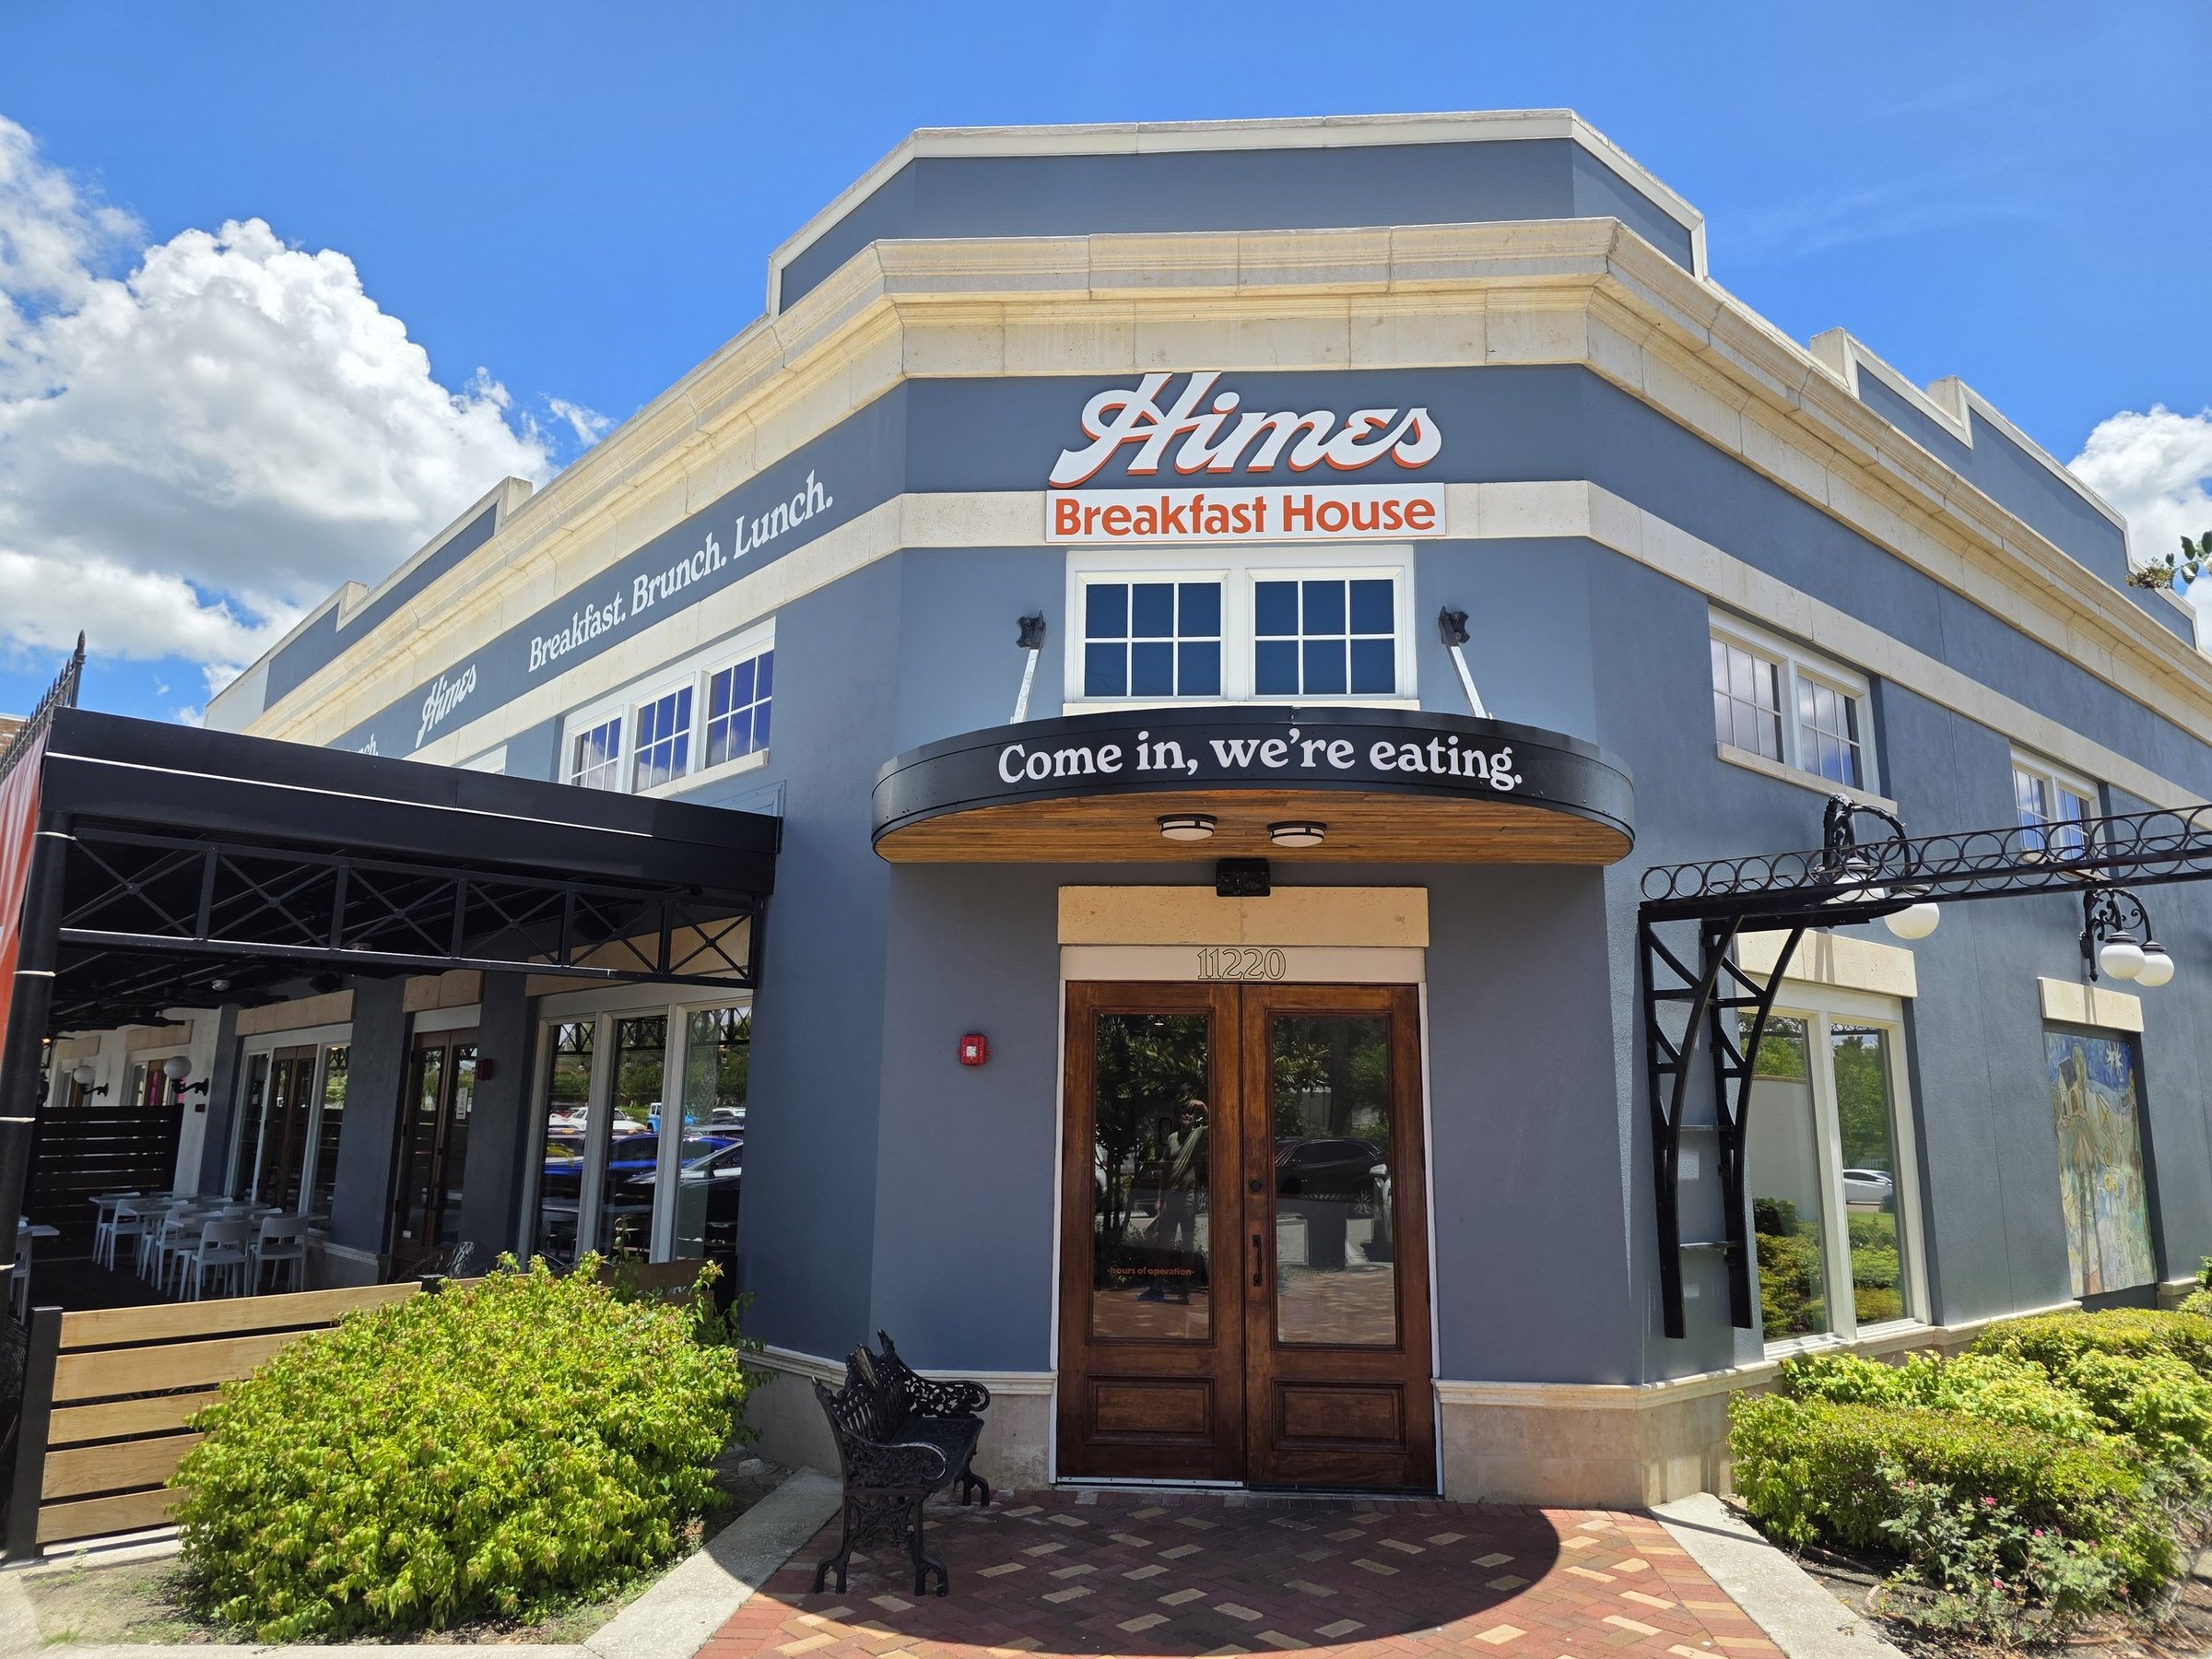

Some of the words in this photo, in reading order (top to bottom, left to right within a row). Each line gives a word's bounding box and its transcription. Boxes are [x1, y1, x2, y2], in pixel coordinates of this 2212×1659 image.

[1048, 371, 1443, 489] Himes
[1054, 493, 1267, 536] Breakfast
[1282, 493, 1437, 532] House
[529, 592, 627, 673] Breakfast.
[630, 532, 726, 616] Brunch.
[733, 469, 833, 559] Lunch.
[415, 664, 477, 748] Himes
[998, 743, 1124, 783] Come
[1135, 730, 1199, 776] in,
[1209, 726, 1356, 769] we’re
[1369, 735, 1524, 792] eating.
[1197, 947, 1287, 980] 11220
[1137, 1266, 1147, 1276] of
